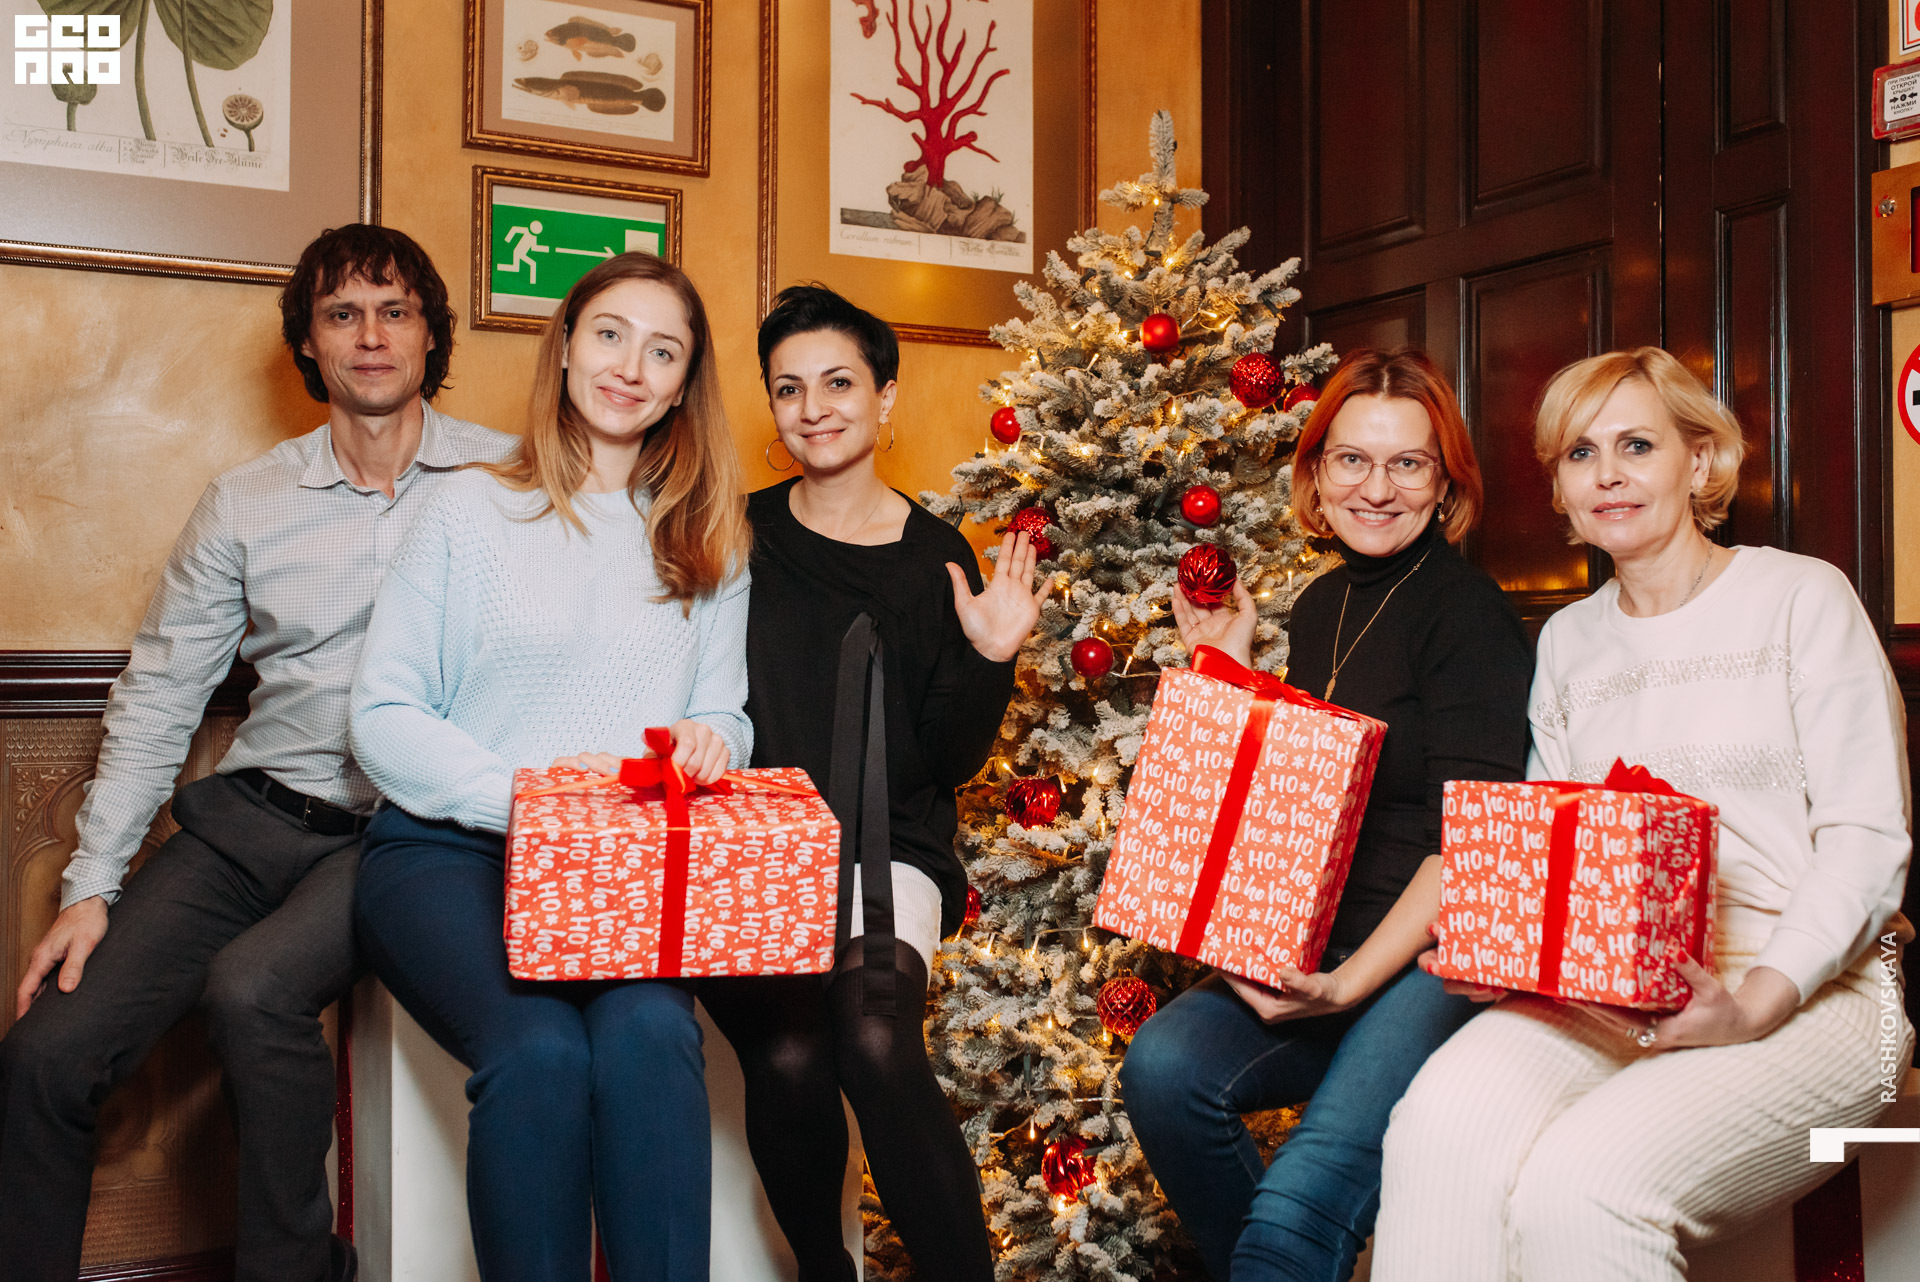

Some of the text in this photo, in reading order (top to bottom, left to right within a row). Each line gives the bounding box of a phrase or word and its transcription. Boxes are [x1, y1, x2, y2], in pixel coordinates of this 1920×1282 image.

[1891, 80, 1917, 90] ОТКРОЙ
[1891, 100, 1916, 110] НАЖМИ
[1159, 706, 1184, 731] HO
[1191, 717, 1212, 743] ho
[1265, 744, 1287, 769] ho
[1308, 754, 1336, 779] HO
[1164, 681, 1185, 706] ho
[1185, 692, 1209, 717] HO
[1212, 698, 1233, 725] ho
[1288, 723, 1309, 750] ho
[1313, 727, 1337, 753] ho
[1142, 755, 1314, 828] ho HO ho ho ho
[1161, 732, 1184, 761] ho
[1195, 748, 1222, 770] HO
[1270, 774, 1299, 795] HO
[1312, 780, 1335, 810] ho
[1137, 781, 1313, 856] HO ho ho HO
[1140, 808, 1162, 836] ho
[1174, 824, 1200, 845] HO
[1249, 850, 1276, 870] HO
[1289, 856, 1313, 886] ho
[1444, 821, 1466, 846] ho
[1487, 819, 1514, 844] HO
[1521, 826, 1545, 852] ho
[1602, 831, 1627, 860] ho
[1461, 790, 1481, 820] ho
[1482, 790, 1507, 818] ho
[1508, 800, 1535, 822] HO
[1588, 804, 1616, 827] HO
[1621, 798, 1644, 831] ho
[622, 843, 657, 869] ho
[1120, 831, 1142, 857] ho
[1142, 844, 1166, 868] HO
[1169, 850, 1190, 877] ho
[1244, 874, 1265, 902] ho
[1269, 879, 1291, 905] ho
[1454, 849, 1482, 872] HO
[1497, 845, 1521, 880] ho
[1532, 857, 1548, 880] H
[1576, 851, 1601, 888] ho
[1613, 862, 1644, 888] HO
[508, 911, 531, 938] ho
[533, 844, 569, 980] ho HO ho H
[560, 832, 594, 977] HO ho HO ho
[590, 828, 622, 966] ho HO ho ho HO
[625, 880, 648, 910] HO
[707, 842, 743, 976] ho HO ho H
[733, 831, 767, 972] HO ho HO ho
[761, 825, 794, 961] ho HO ho ho HO
[791, 841, 827, 975] ho HO ho H
[1116, 856, 1290, 933] HO ho ho HO
[1118, 882, 1140, 912] ho
[1152, 900, 1178, 921] HO
[1227, 925, 1253, 946] HO
[1266, 932, 1290, 963] ho
[1441, 882, 1460, 907] ho
[1517, 892, 1540, 917] ho
[1595, 899, 1621, 928] ho
[621, 926, 655, 952] ho
[1098, 905, 1119, 931] ho
[1246, 954, 1268, 980] ho
[1270, 974, 1283, 990] H
[1438, 945, 1447, 965] O
[1451, 940, 1471, 971] ho
[1472, 942, 1498, 970] ho
[1499, 956, 1525, 978] HO
[1580, 967, 1608, 991] HO
[1613, 964, 1637, 998] ho
[1448, 910, 1475, 933] HO
[1490, 908, 1515, 943] ho
[1527, 922, 1543, 945] H
[1572, 918, 1596, 956] ho
[1607, 932, 1639, 957] HO
[623, 963, 644, 979] H
